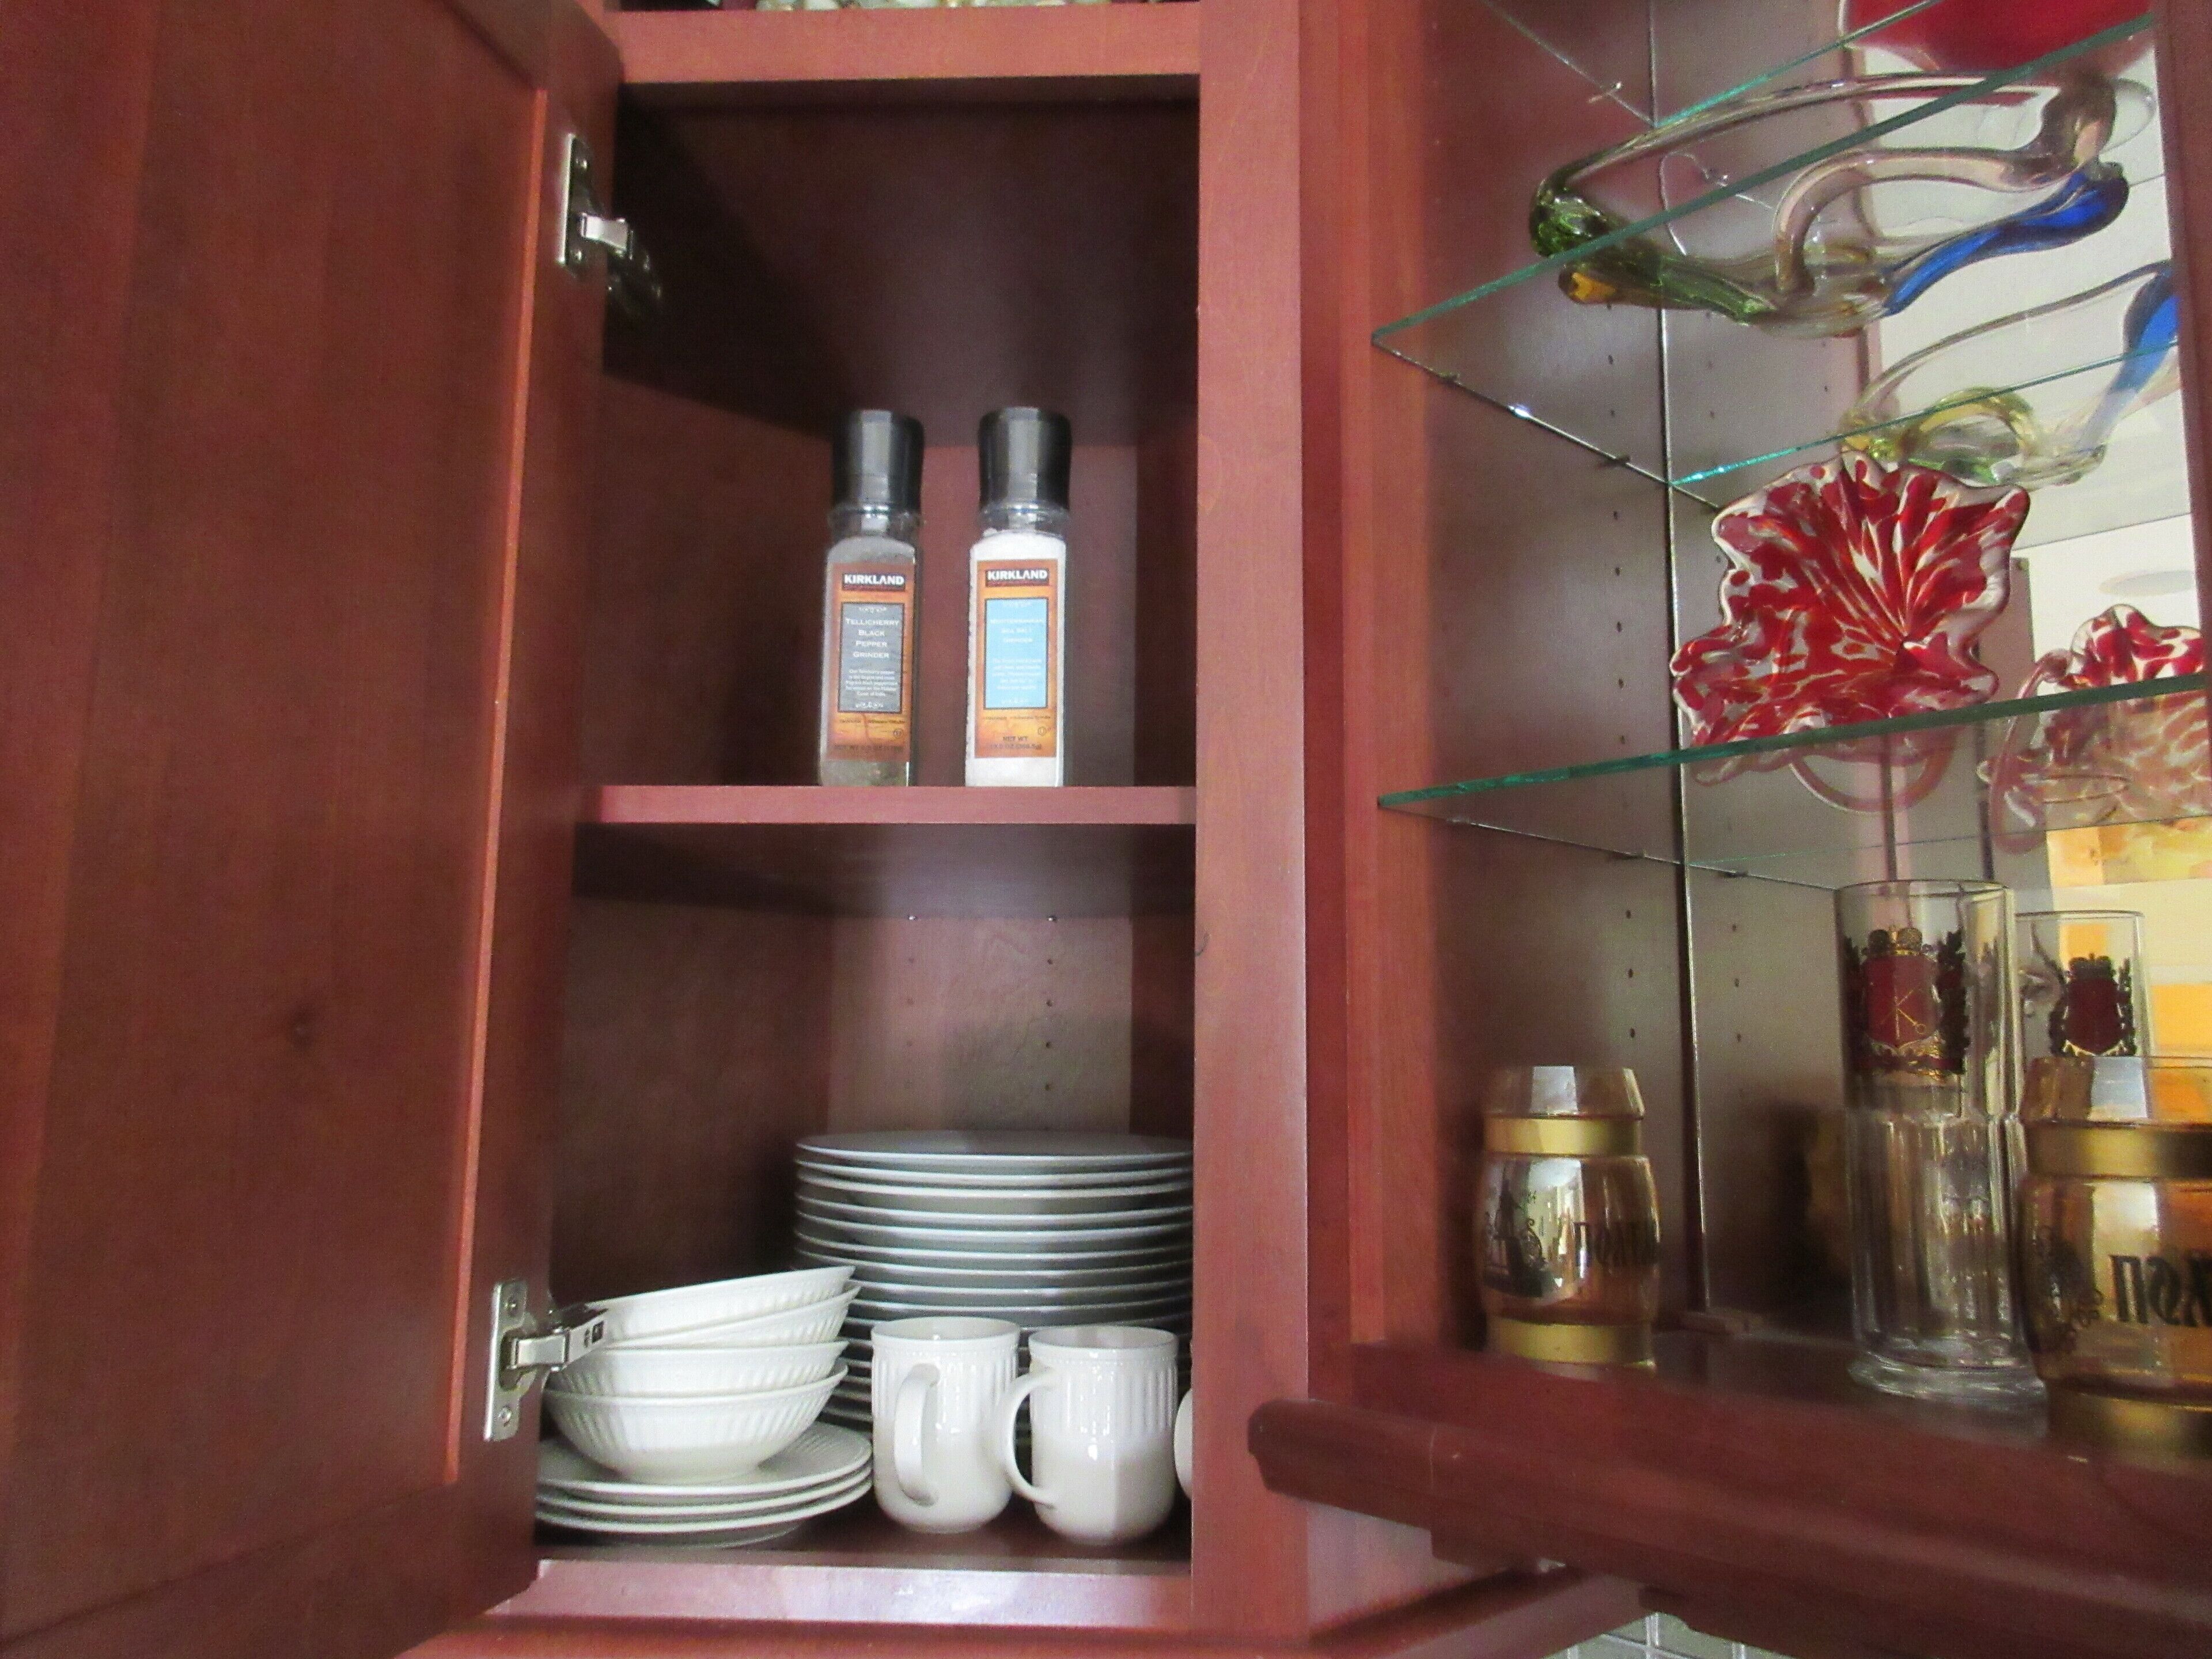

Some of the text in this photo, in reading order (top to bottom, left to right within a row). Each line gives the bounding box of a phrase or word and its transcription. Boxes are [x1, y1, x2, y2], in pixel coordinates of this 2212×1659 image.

[844, 574, 905, 585] KIRKLAND
[987, 569, 1048, 580] KIRKLAND
[845, 618, 900, 626] TELLICHERRY
